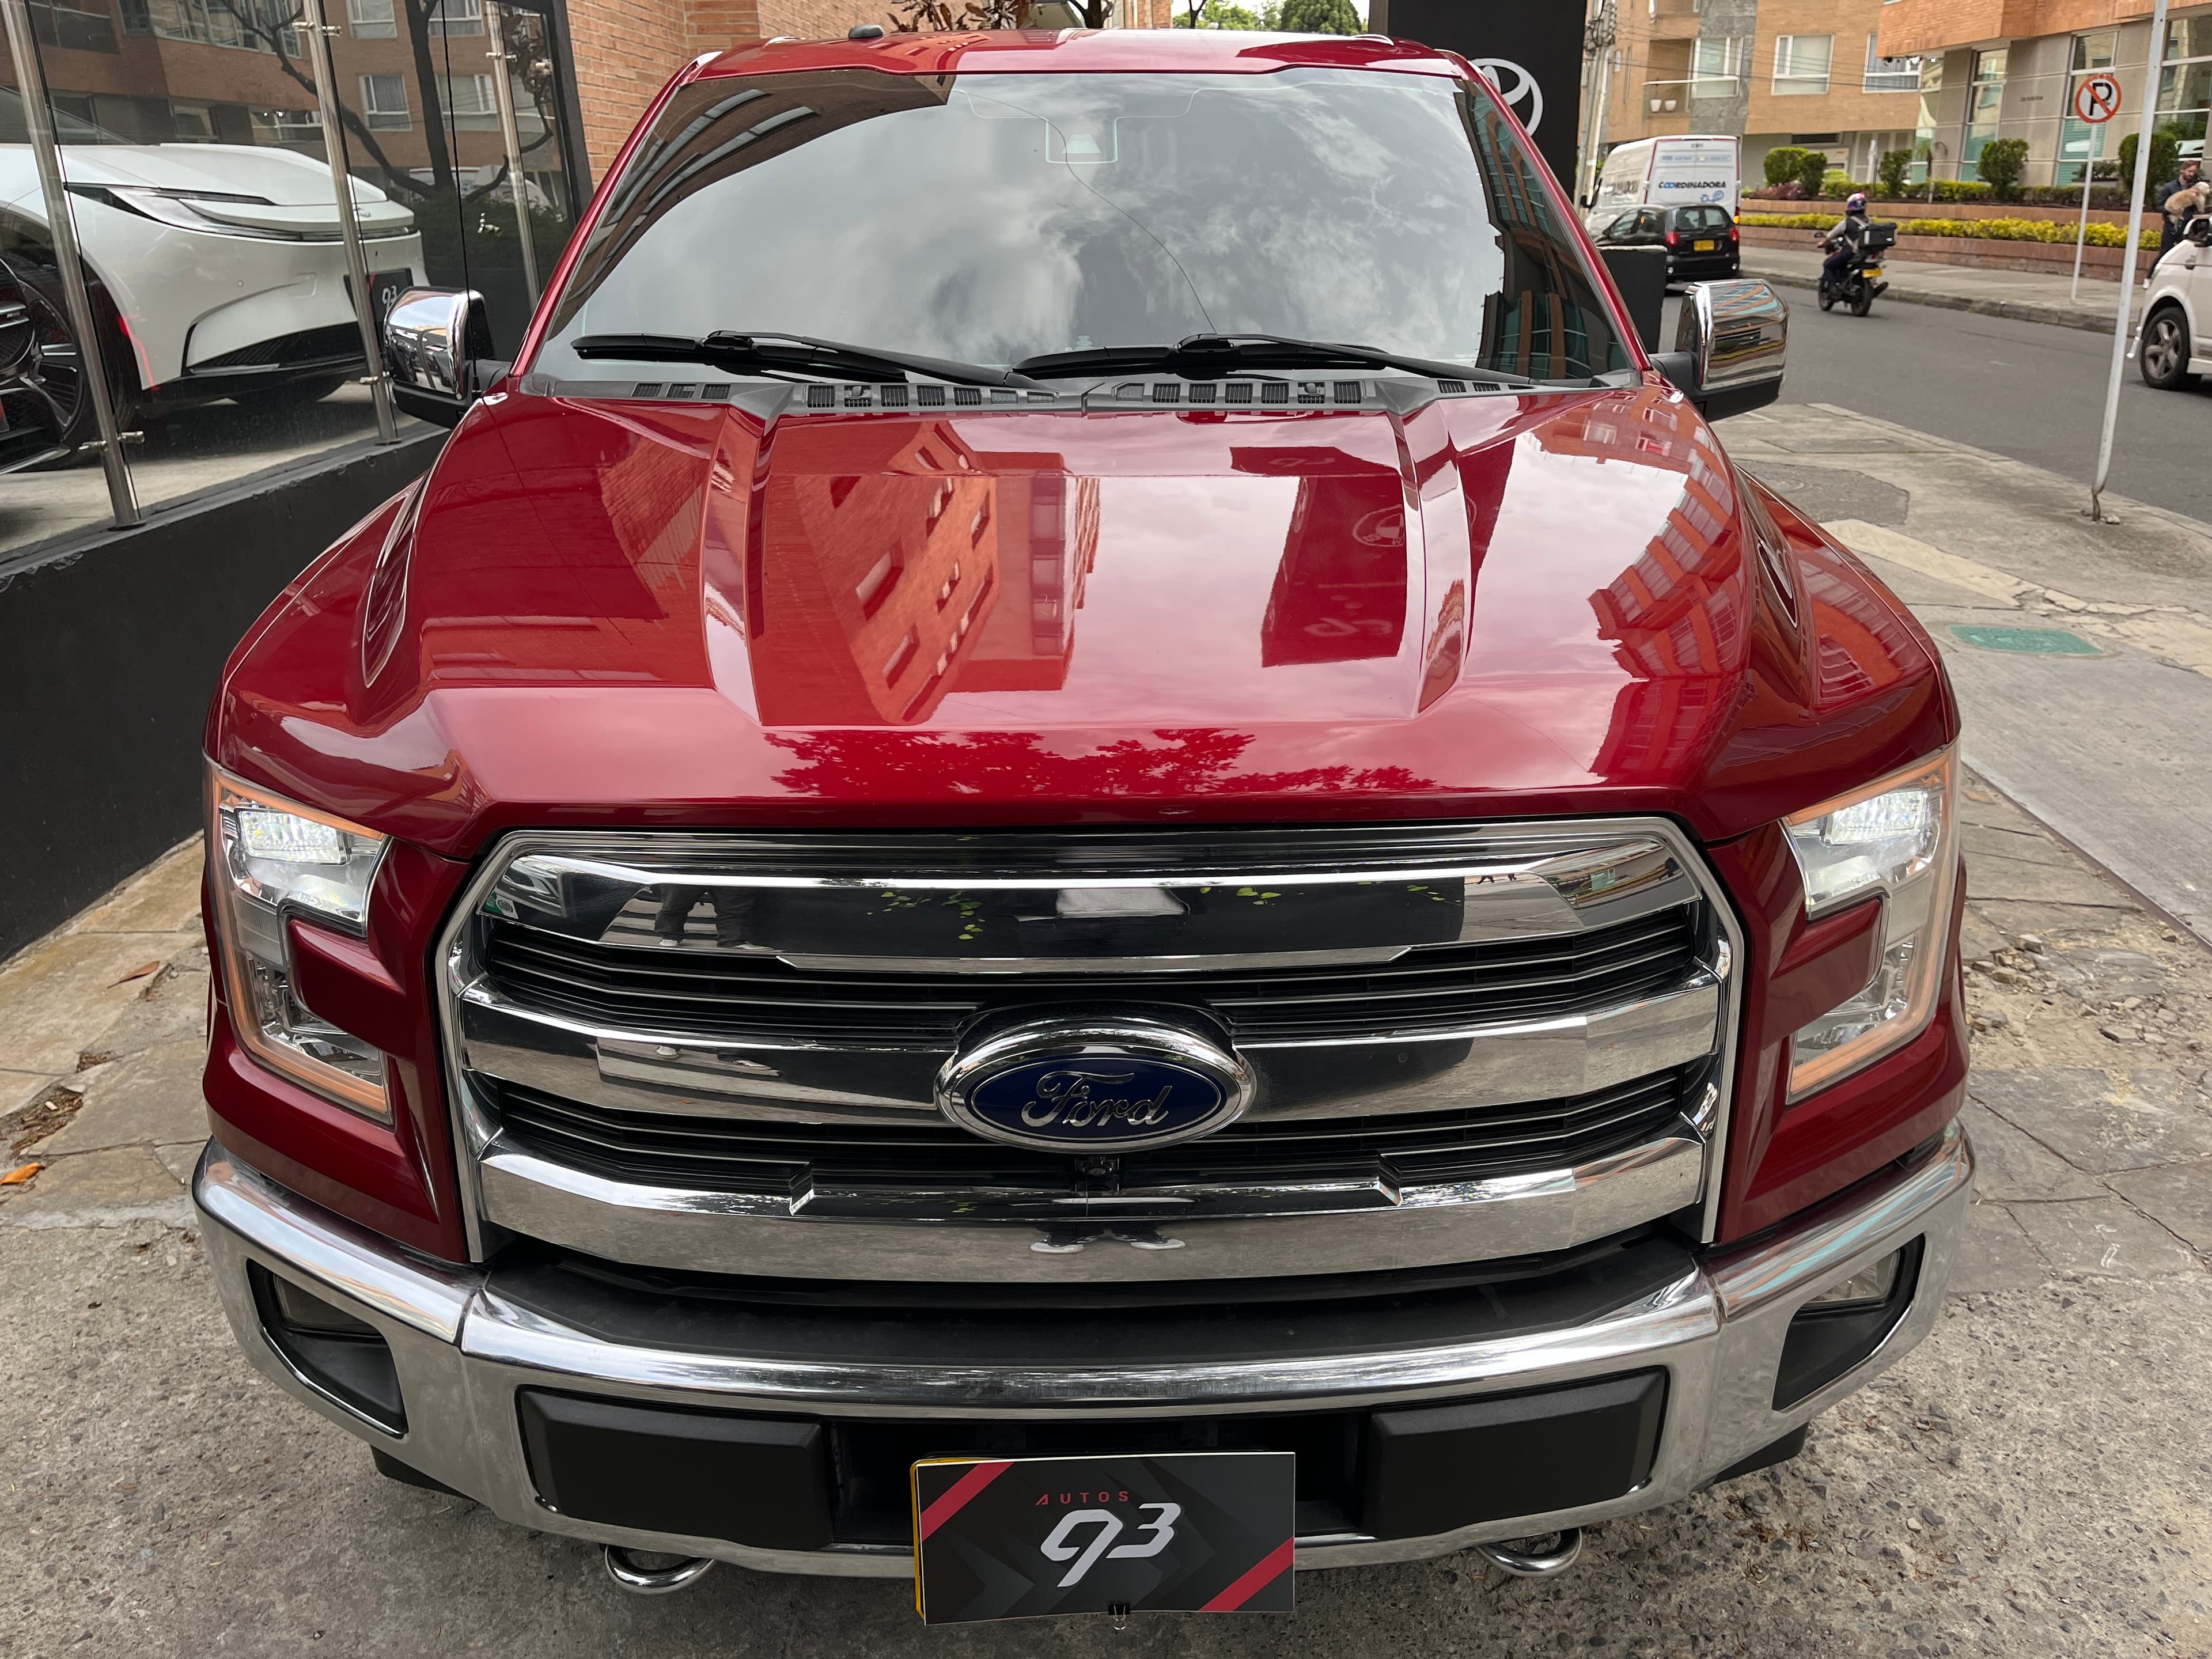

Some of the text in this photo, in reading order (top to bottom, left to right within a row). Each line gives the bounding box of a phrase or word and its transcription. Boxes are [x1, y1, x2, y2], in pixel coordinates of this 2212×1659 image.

[2089, 82, 2112, 116] P
[1021, 1071, 1172, 1127] Ford
[1035, 1491, 1128, 1505] AUTOS
[1040, 1502, 1181, 1588] 93
